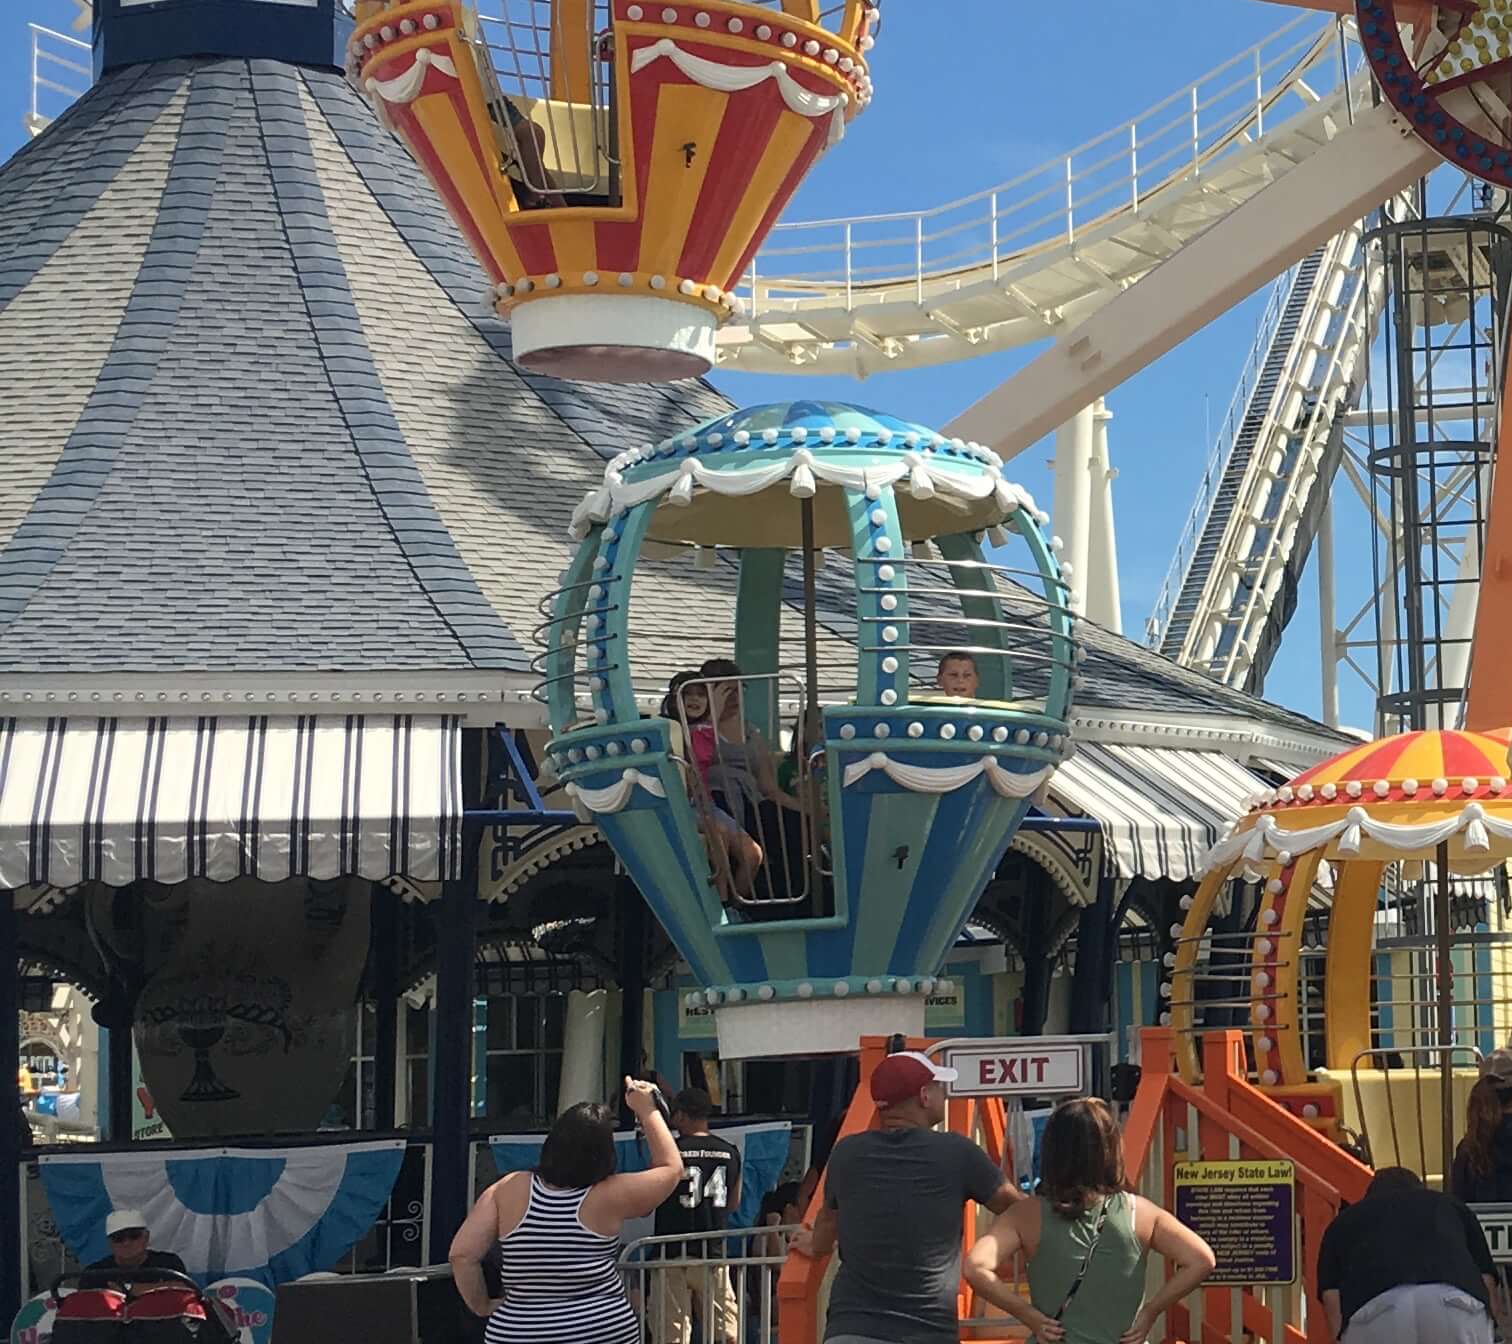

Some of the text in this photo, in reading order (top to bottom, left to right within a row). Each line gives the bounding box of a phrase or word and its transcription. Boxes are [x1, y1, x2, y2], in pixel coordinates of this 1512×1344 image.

[979, 1057, 1050, 1084] EXIT
[1176, 1165, 1292, 1182] New Jersey State Law!
[680, 1167, 728, 1208] 34
